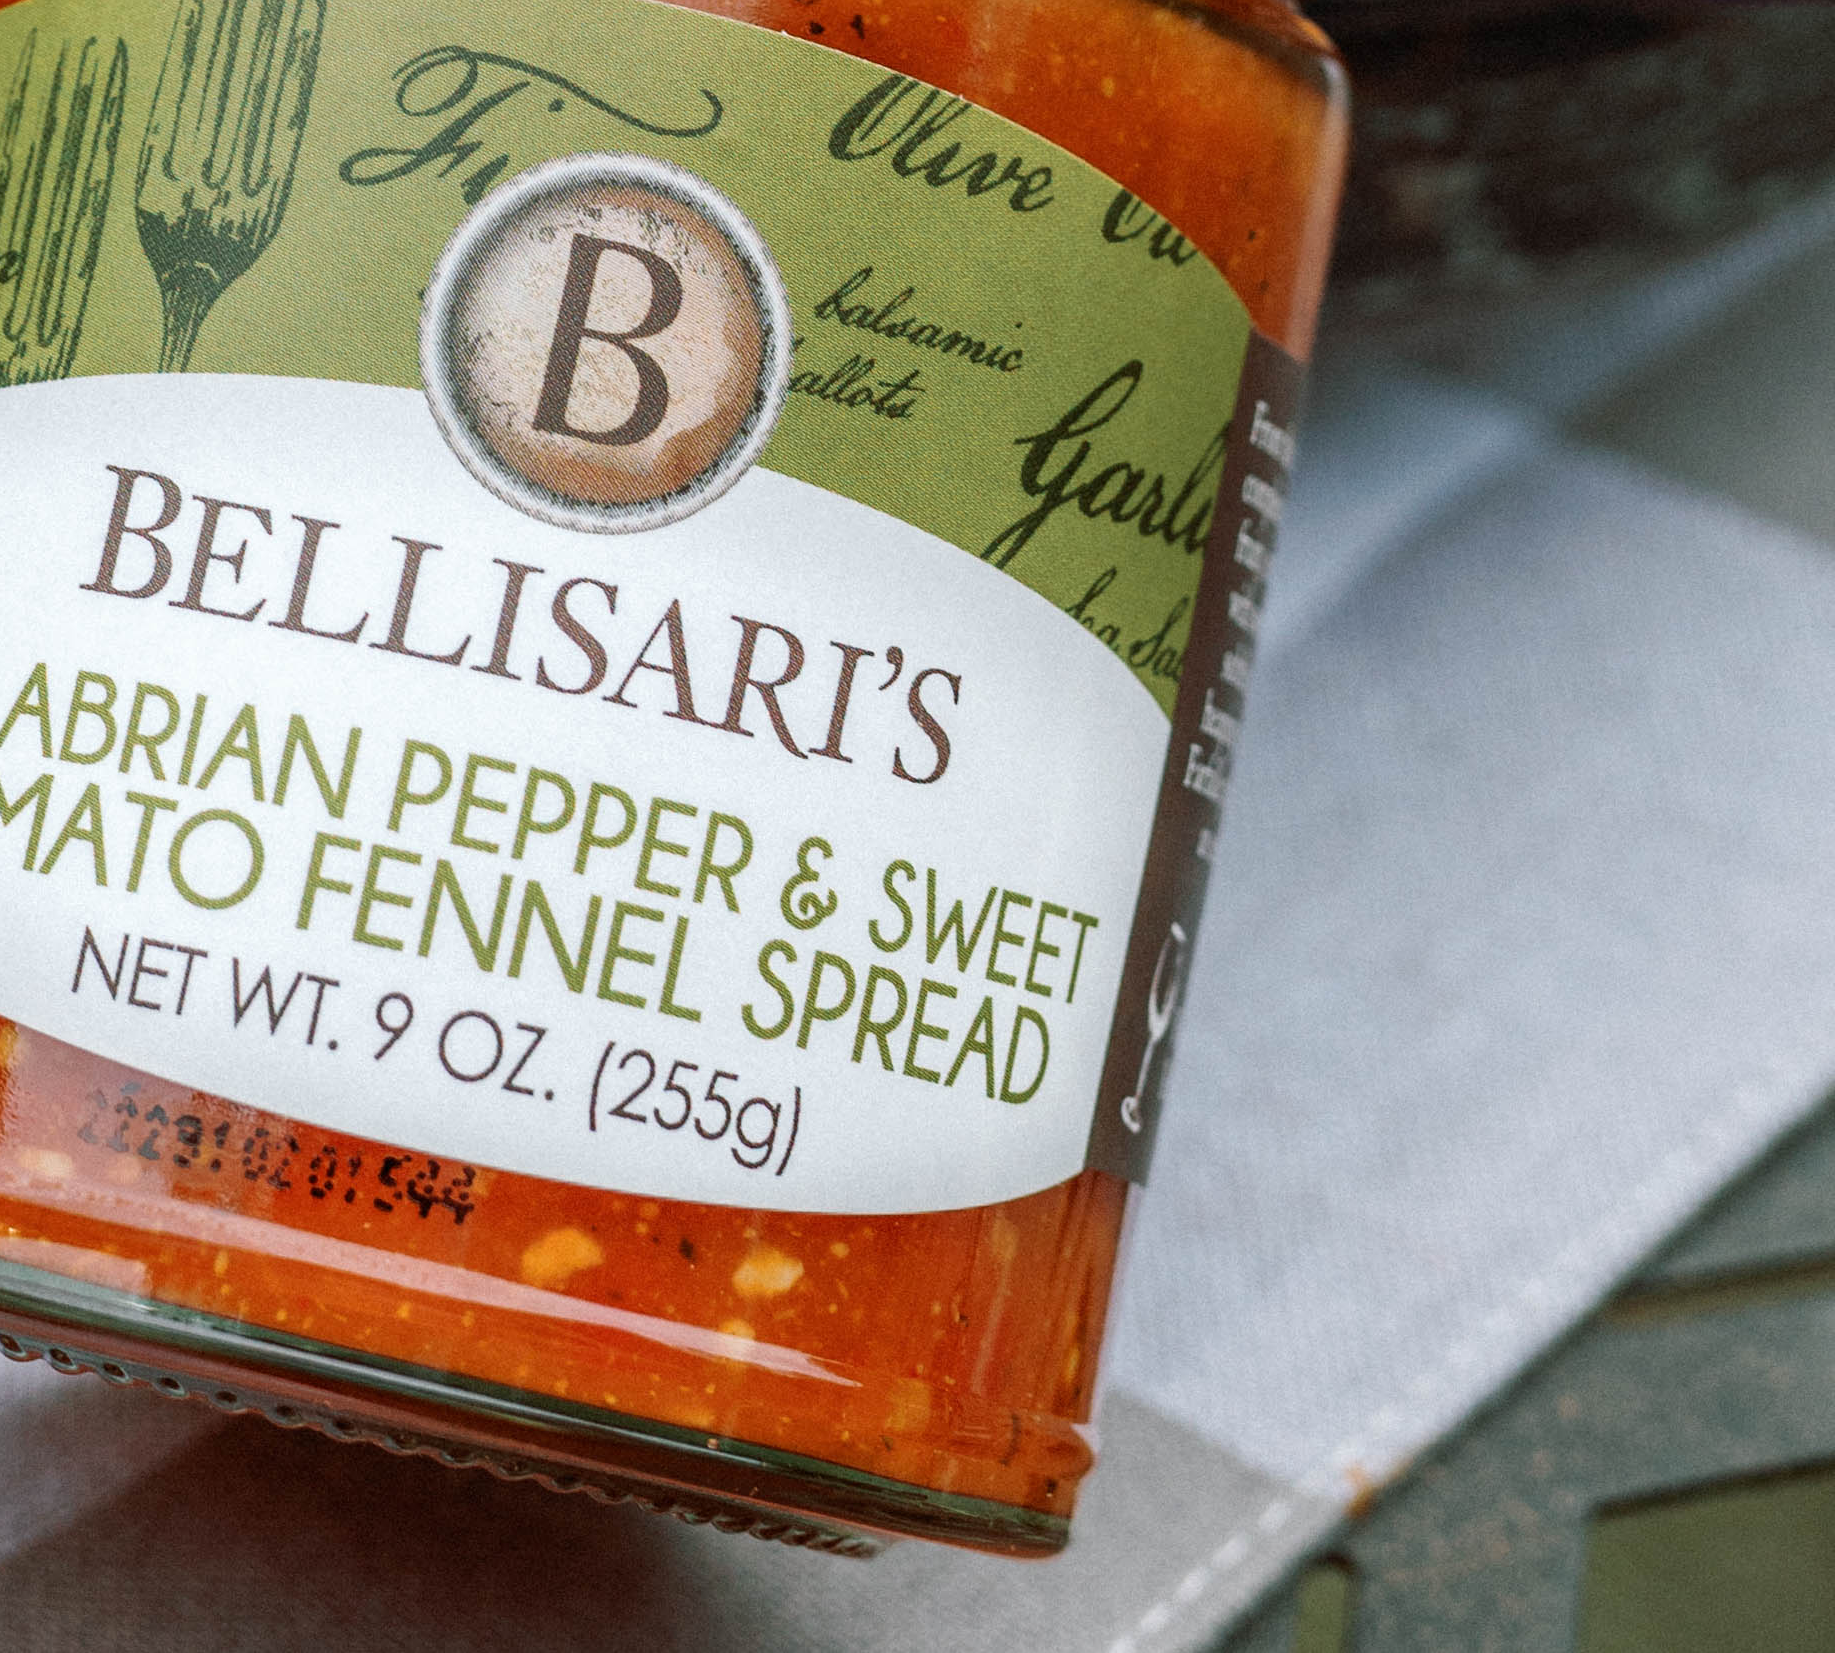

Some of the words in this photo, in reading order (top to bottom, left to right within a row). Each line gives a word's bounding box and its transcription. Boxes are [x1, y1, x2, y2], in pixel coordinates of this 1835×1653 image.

[827, 73, 1054, 212] Olive
[532, 233, 683, 446] B
[787, 355, 927, 420] allots
[815, 267, 1023, 373] balsamic
[79, 464, 962, 784] BELLISARI'S
[296, 832, 701, 1023] FENNEL
[741, 938, 1050, 1105] SPREAD
[387, 738, 754, 914] PEPPER
[781, 836, 837, 930] &
[867, 858, 1099, 1004] SWEET
[71, 925, 208, 1016] NET
[232, 957, 340, 1050] WT.
[374, 992, 414, 1061] 9
[439, 1010, 556, 1102] OZ.
[589, 1041, 802, 1176] (255g)
